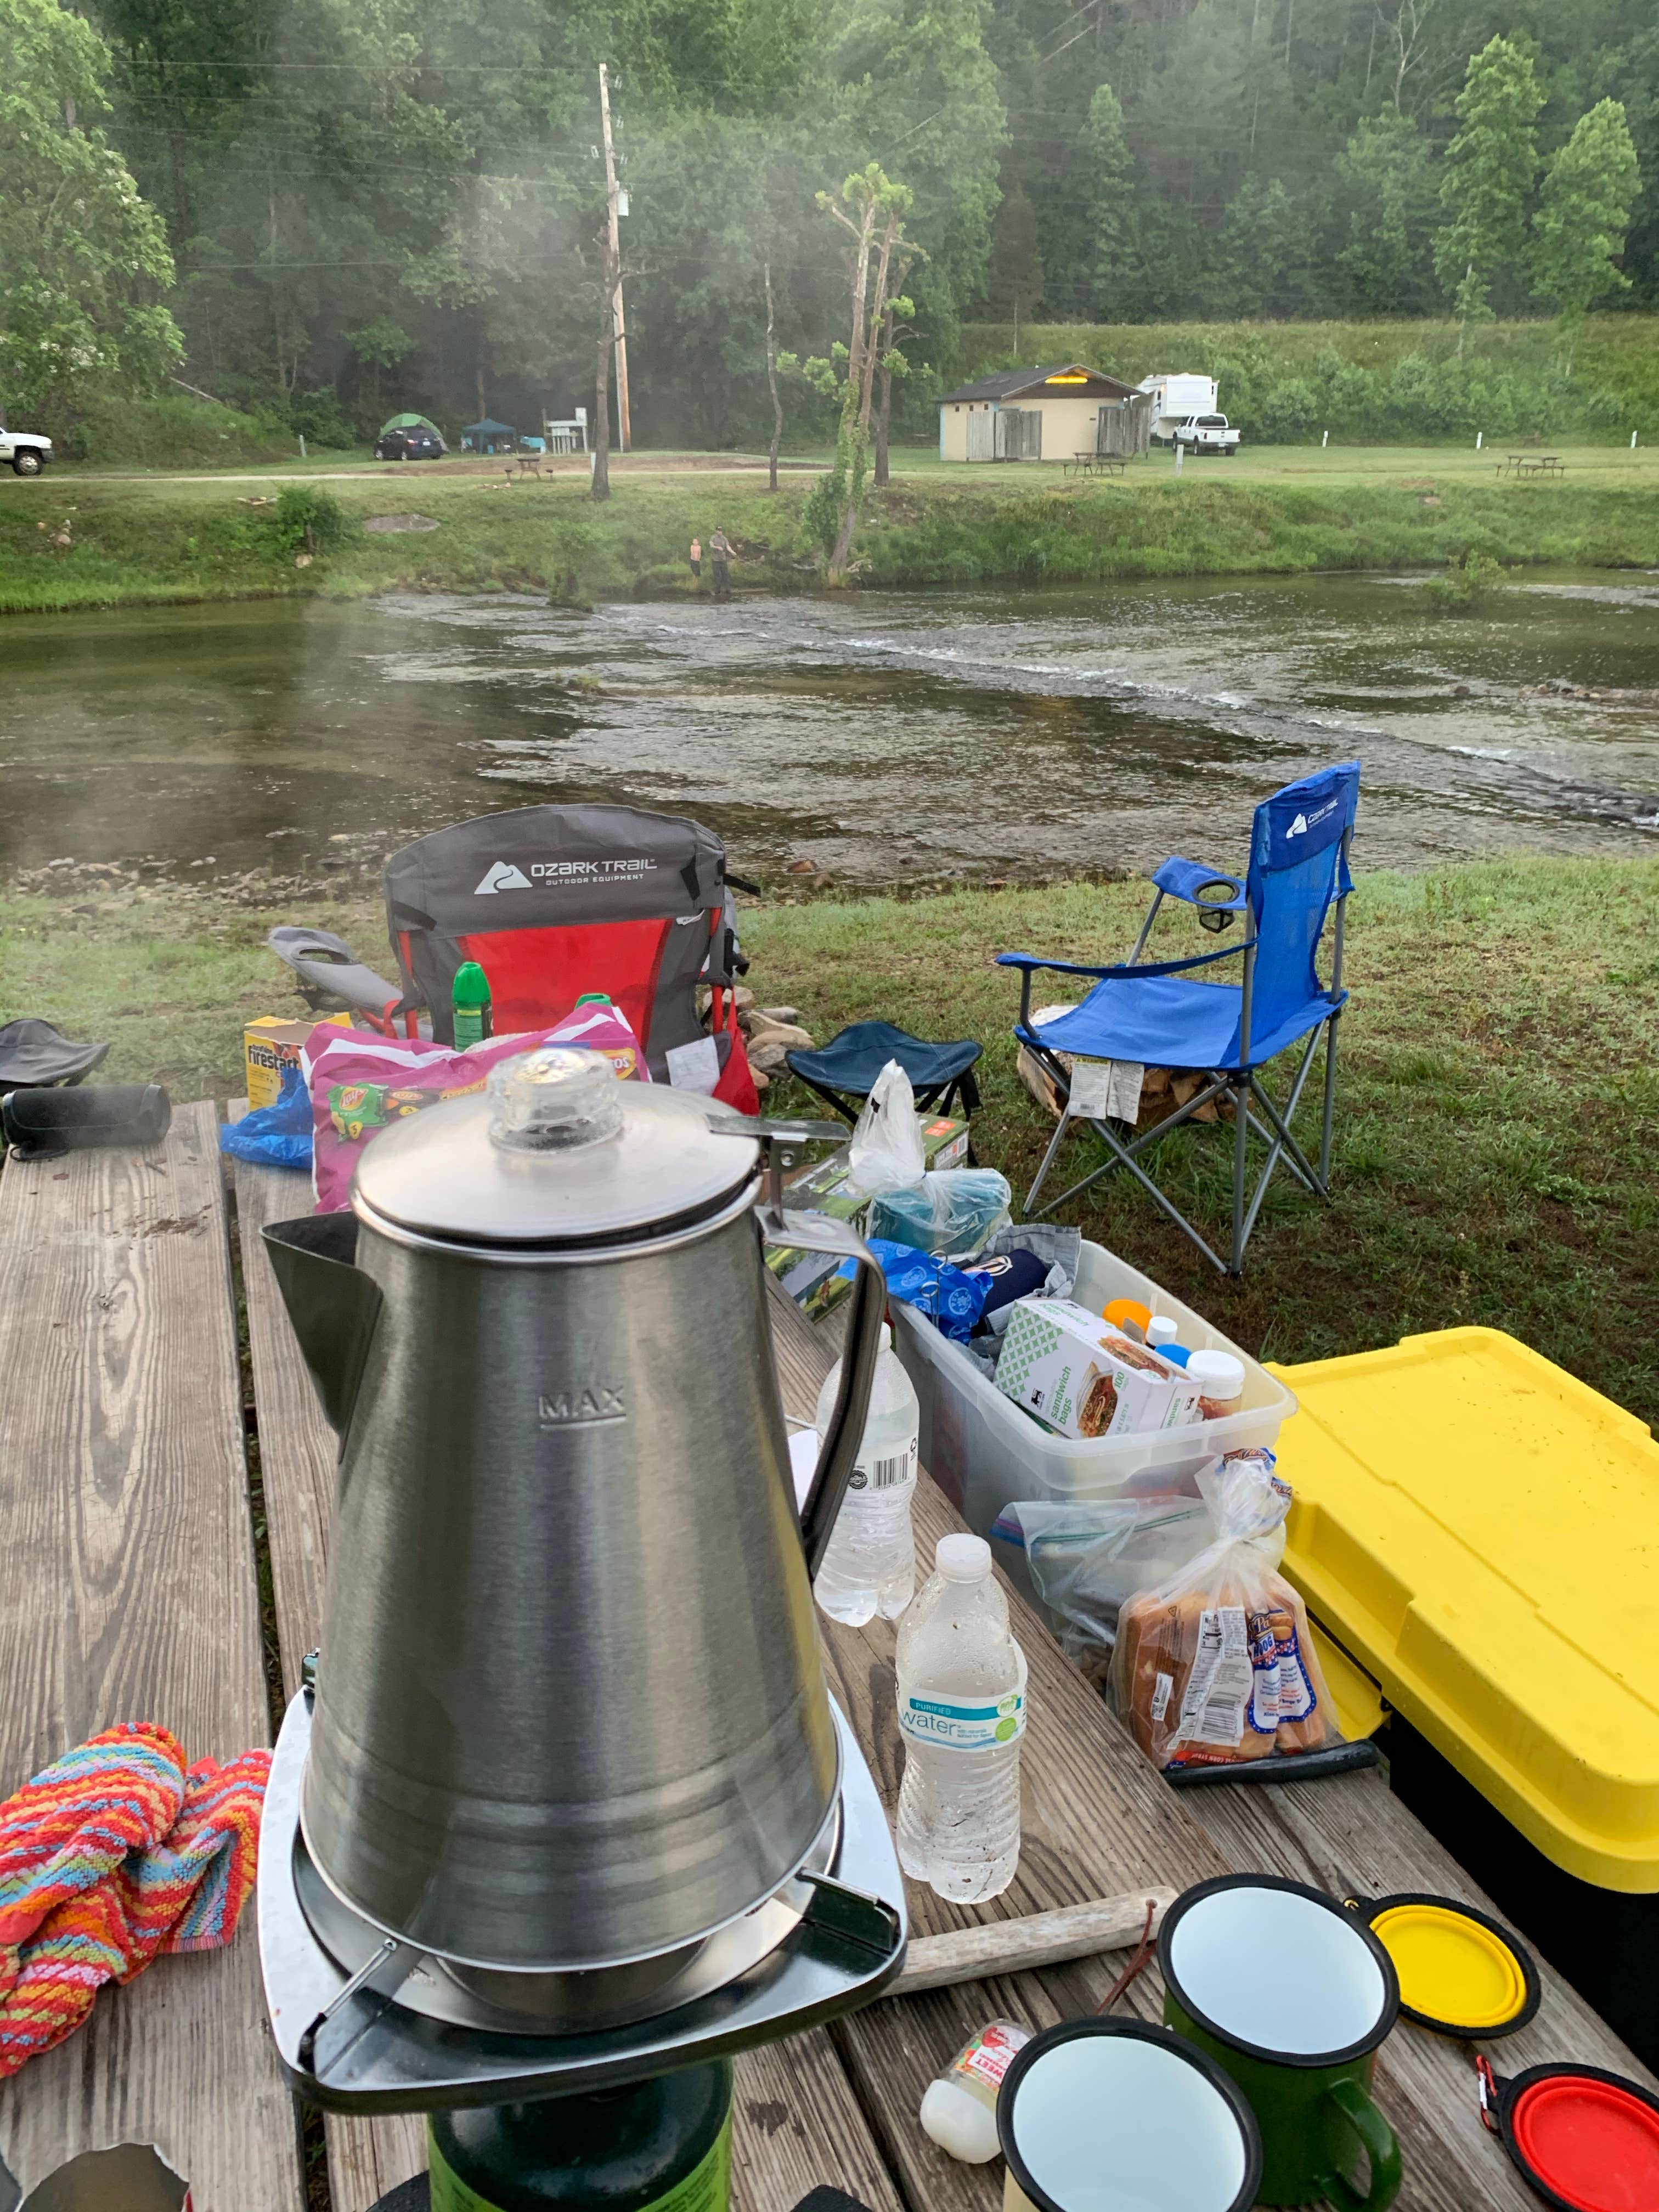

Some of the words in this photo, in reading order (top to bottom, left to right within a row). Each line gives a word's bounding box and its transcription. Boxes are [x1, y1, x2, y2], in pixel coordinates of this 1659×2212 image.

[531, 861, 599, 877] OZARK
[601, 859, 657, 872] TRAIL
[545, 877, 589, 886] OUTDOOR
[592, 873, 644, 883] EQUIPMENT
[1114, 1371, 1125, 1389] 100
[539, 1385, 625, 1418] MAX
[1051, 1366, 1071, 1420] sandwich
[1057, 1397, 1072, 1425] bags
[915, 1702, 952, 1716] PURIFIED
[901, 1707, 957, 1736] water
[975, 2058, 1003, 2079] WEET
